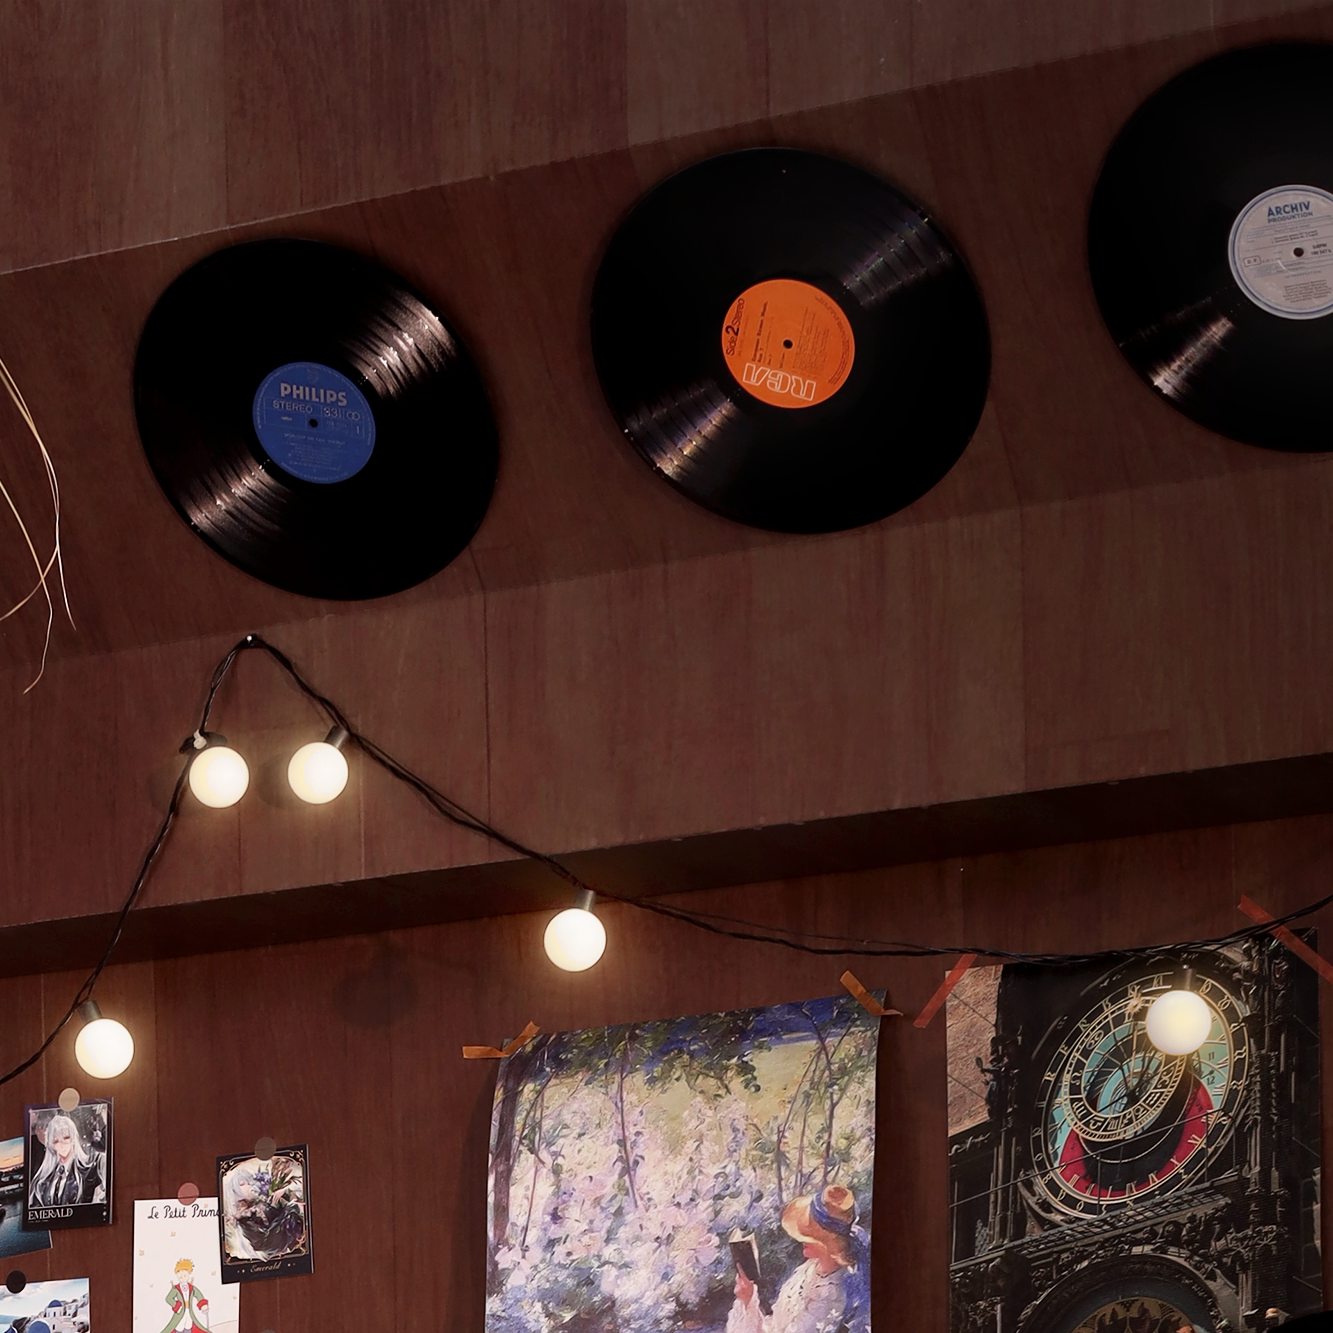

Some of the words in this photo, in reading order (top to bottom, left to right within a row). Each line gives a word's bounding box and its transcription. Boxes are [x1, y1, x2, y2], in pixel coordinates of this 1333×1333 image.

[1267, 201, 1311, 217] ARCHIV
[1268, 211, 1314, 223] PRODUKTION
[731, 298, 746, 327] Stereo
[725, 324, 740, 338] 2
[726, 336, 738, 357] Side
[742, 362, 817, 401] RCA
[280, 382, 348, 407] PHILIPS
[272, 399, 314, 415] STEREO
[28, 1207, 74, 1220] EMERALD
[147, 1205, 159, 1219] Le
[163, 1205, 187, 1219] Petit
[191, 1203, 220, 1218] Prin
